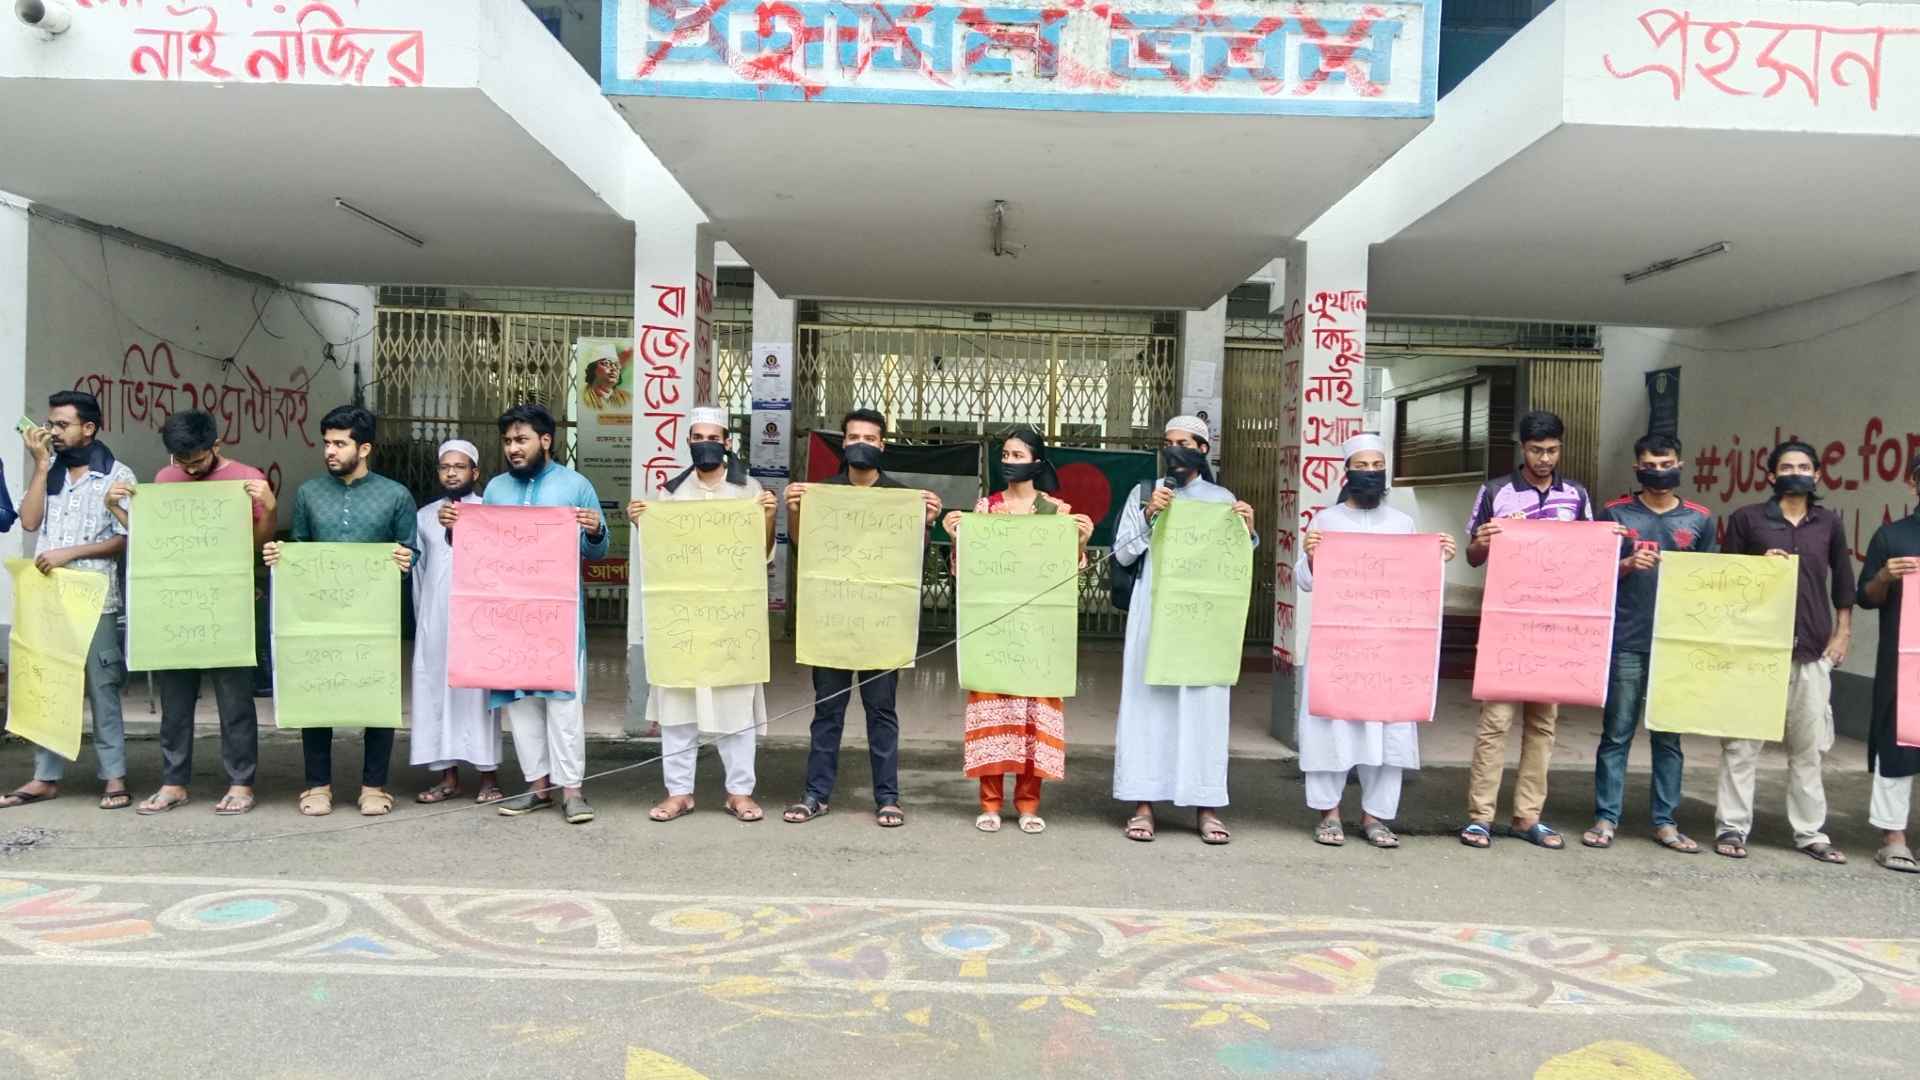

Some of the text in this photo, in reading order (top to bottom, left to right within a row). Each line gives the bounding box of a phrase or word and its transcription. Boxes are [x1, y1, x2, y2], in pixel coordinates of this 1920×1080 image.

[131, 3, 424, 87] নাই নজির
[1304, 363, 1360, 407] নাই
